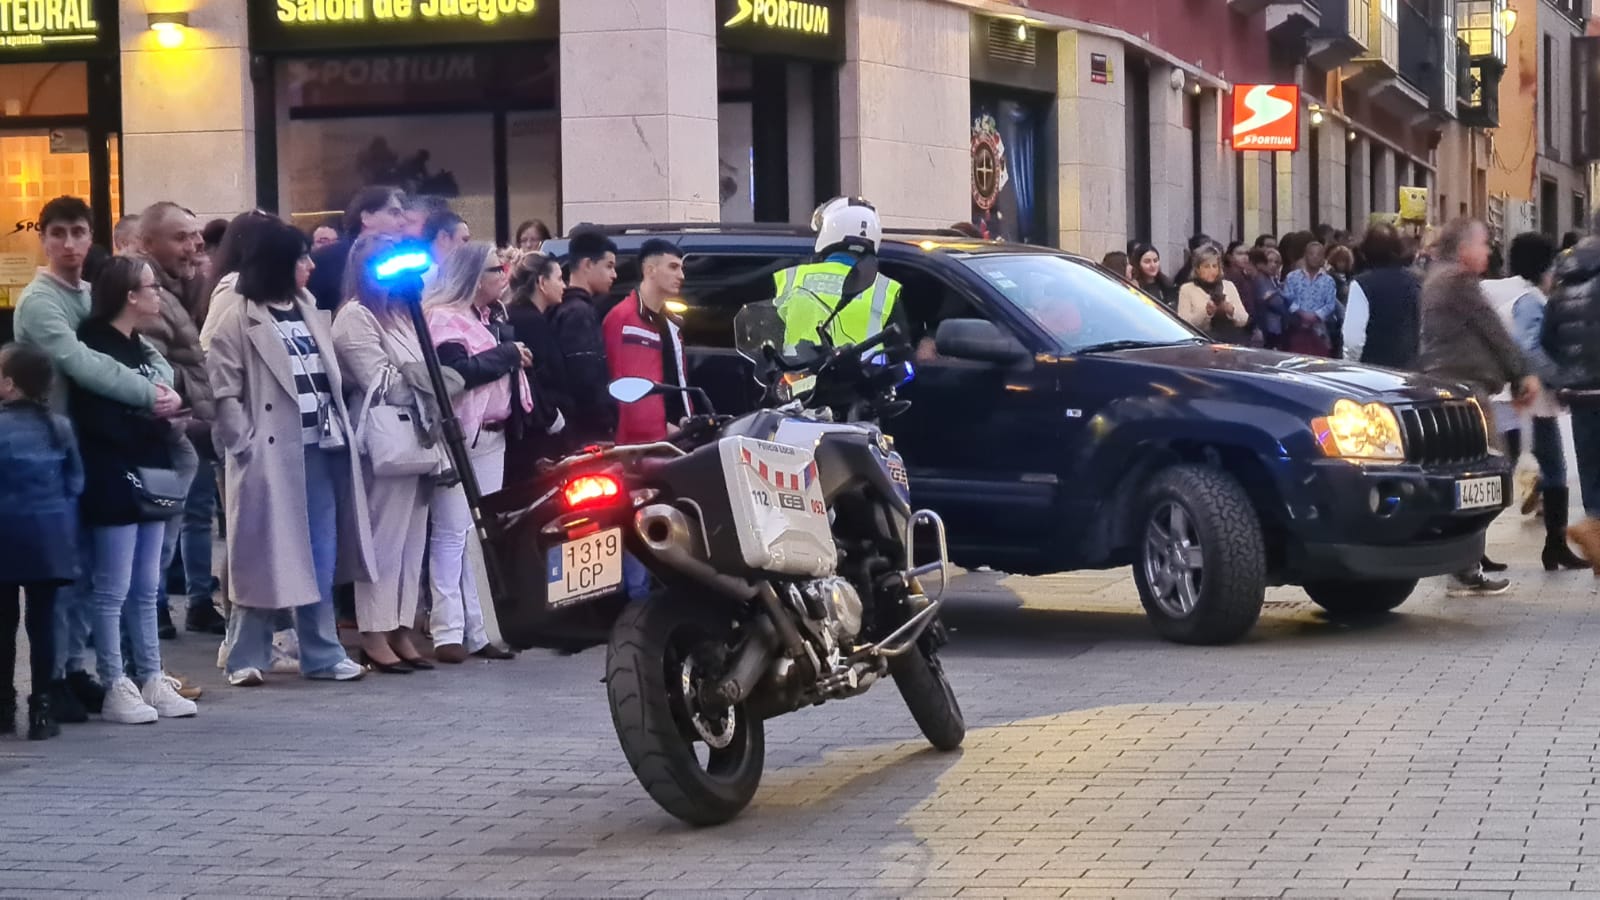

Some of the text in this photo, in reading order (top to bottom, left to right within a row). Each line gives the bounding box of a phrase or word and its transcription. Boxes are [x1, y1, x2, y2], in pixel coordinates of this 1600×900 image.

[372, 0, 412, 18] de
[420, 0, 535, 22] Juegos
[724, 0, 829, 34] SPORTIUM
[1237, 134, 1292, 146] SPORTIUM
[752, 490, 770, 507] 112
[1462, 482, 1485, 504] 4425
[567, 534, 617, 568] 1319
[567, 563, 603, 593] LCP
